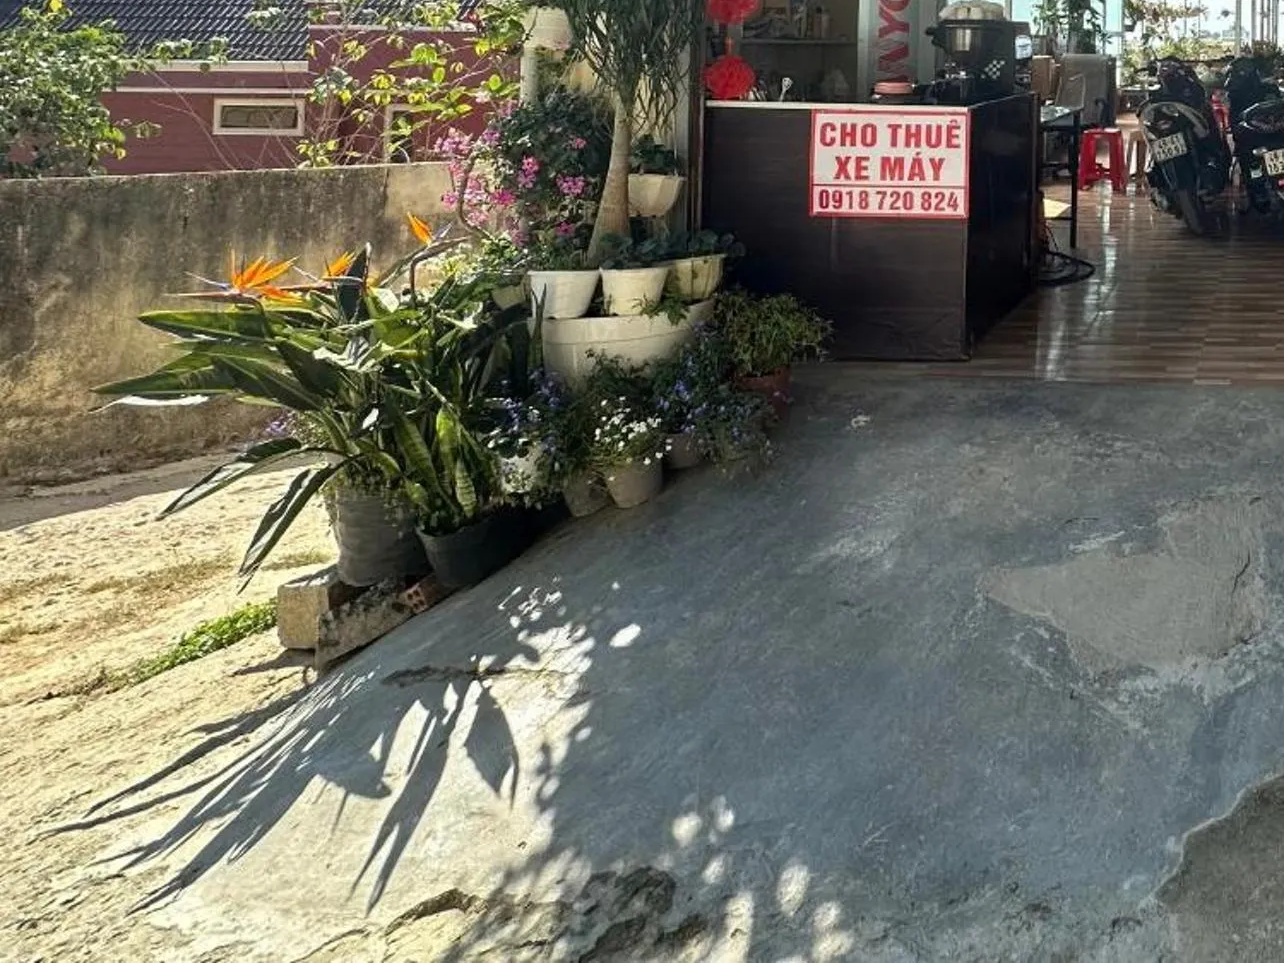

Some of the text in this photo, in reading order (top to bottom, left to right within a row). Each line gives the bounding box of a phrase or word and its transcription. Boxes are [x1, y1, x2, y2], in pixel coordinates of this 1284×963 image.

[819, 119, 961, 149] CHO THUÊ
[833, 151, 945, 181] XE MÁY
[819, 189, 959, 212] 0918 720 824
